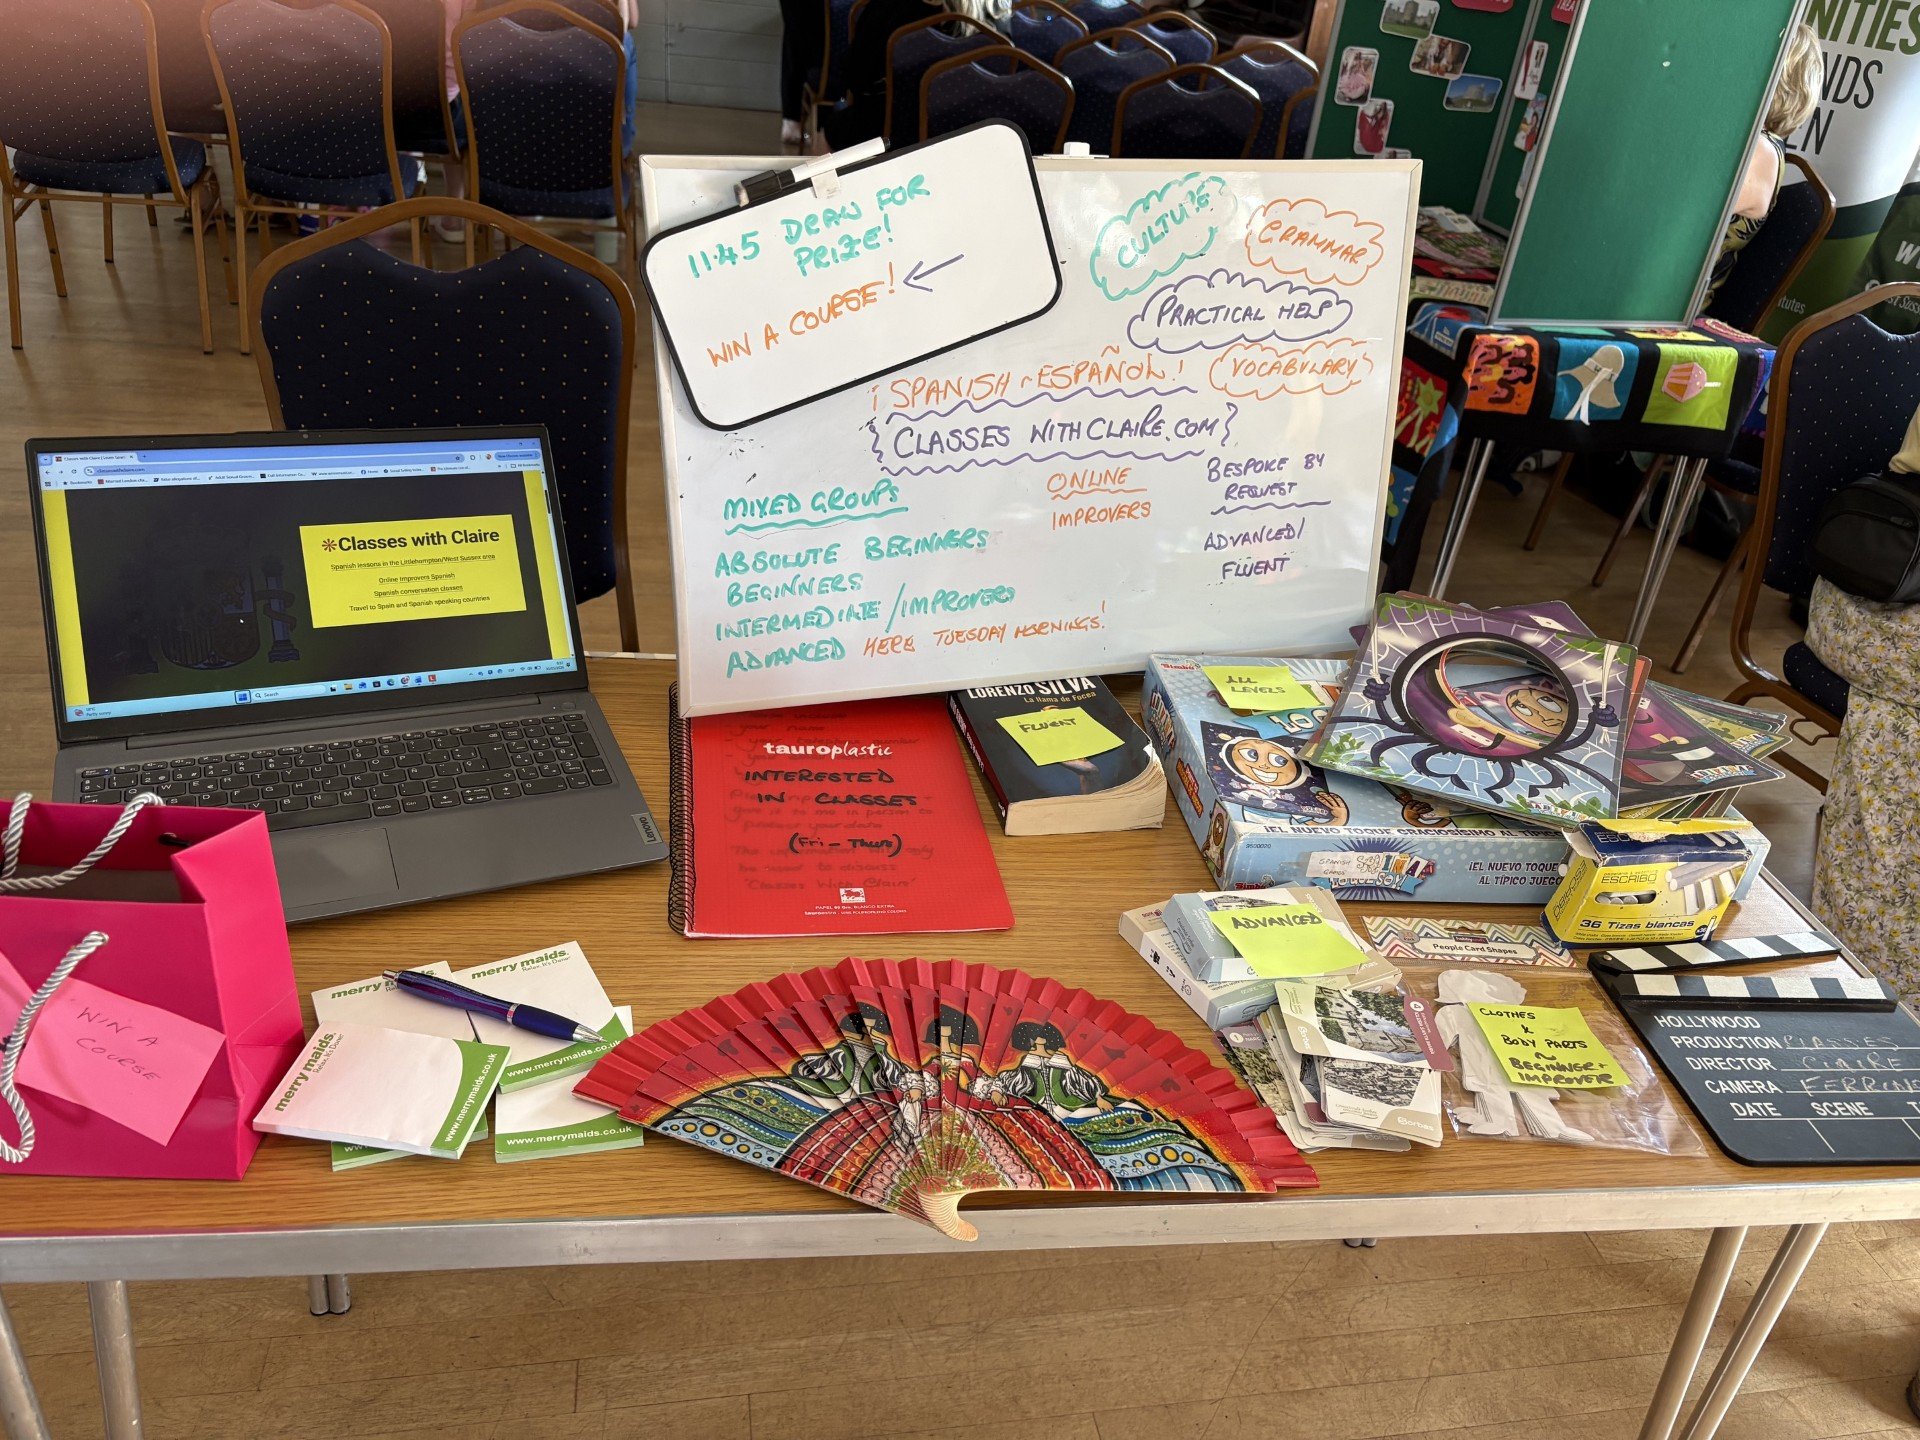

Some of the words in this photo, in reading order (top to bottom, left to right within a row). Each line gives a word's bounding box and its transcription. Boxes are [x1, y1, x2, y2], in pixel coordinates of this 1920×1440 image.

[874, 174, 931, 212] FOR
[793, 213, 896, 277] PRIZE!
[707, 332, 751, 368] WIN
[763, 323, 780, 350] A
[788, 261, 897, 337] COURSE!
[1156, 294, 1266, 328] PRACTICAL
[1278, 300, 1333, 321] HELP
[1231, 356, 1359, 379] VOCABULARY
[893, 425, 1011, 459] CLASSES
[1207, 456, 1290, 483] BESPOKE
[1304, 453, 1326, 472] BY
[1046, 467, 1133, 494] ONLINE
[723, 495, 802, 521] MIXED
[810, 477, 900, 513] GROUPS
[1225, 481, 1298, 502] REQUEST
[1051, 501, 1152, 531] IMPROVERS
[337, 535, 409, 553] Classes
[411, 530, 448, 548] with
[451, 527, 501, 546] Claire
[714, 542, 842, 578] ABSOLUTE
[863, 526, 989, 562] BEGINNERS
[330, 563, 357, 572] Spanish
[357, 560, 382, 569] lessons
[389, 558, 400, 567] the
[460, 553, 481, 562] Sussex
[482, 553, 496, 561] area
[1221, 557, 1291, 581] FLUENT
[378, 576, 399, 585] Online
[399, 573, 430, 584] Improvers
[431, 572, 455, 581] Spanish
[374, 589, 399, 598] Spanish
[400, 585, 439, 596] conversation
[440, 584, 463, 593] classes
[726, 572, 864, 608] BEGINNERS
[349, 604, 369, 613] Travel
[369, 603, 376, 611] to
[377, 602, 395, 611] Spain
[396, 601, 408, 609] and
[408, 599, 434, 609] Spanish
[434, 597, 462, 607] speaking
[462, 594, 491, 604] countries
[726, 636, 847, 679] ADVANCED
[863, 634, 916, 658] HERE
[933, 621, 1007, 650] TUESDAY
[967, 684, 1034, 700] LORENZO
[1033, 675, 1097, 696] SILVA
[1024, 696, 1034, 704] La
[1036, 695, 1059, 704] llama
[1060, 694, 1071, 703] de
[1071, 690, 1097, 702] Focea
[762, 740, 894, 760] tauroplastic
[743, 767, 896, 784] INTERESTED
[757, 791, 786, 804] IN
[639, 816, 657, 843] Lenovo
[1487, 861, 1522, 872] NUEVO
[1525, 861, 1559, 873] TOQUE
[1478, 875, 1491, 885] AL
[1494, 873, 1527, 885] TÍPICO
[1230, 911, 1323, 930] ADVANCED
[1579, 919, 1602, 929] 36
[1608, 921, 1641, 930] Tizas
[1645, 919, 1695, 930] blancas
[1433, 942, 1463, 952] People
[1464, 945, 1486, 953] Card
[1487, 946, 1518, 955] Shapes
[470, 962, 519, 981] merry
[331, 982, 383, 1000] merry
[1479, 1007, 1536, 1020] CLOTHES
[1653, 1015, 1762, 1030] HOLLYWOOD
[76, 1005, 132, 1035] WIN
[137, 1034, 158, 1048] A
[1545, 1038, 1589, 1050] PARTS
[1669, 1035, 1784, 1050] PRODUCTION
[76, 1037, 162, 1082] COURSE
[1684, 1056, 1779, 1072] DIRECTOR
[274, 1071, 310, 1113] merry
[444, 1051, 499, 1143] www.merrymaids.co.uk
[1703, 1079, 1785, 1095] CAMERA
[1729, 1101, 1783, 1118] DATE
[1810, 1101, 1875, 1117] SCENE
[505, 1124, 634, 1147] www.merrymaids.co.uk
